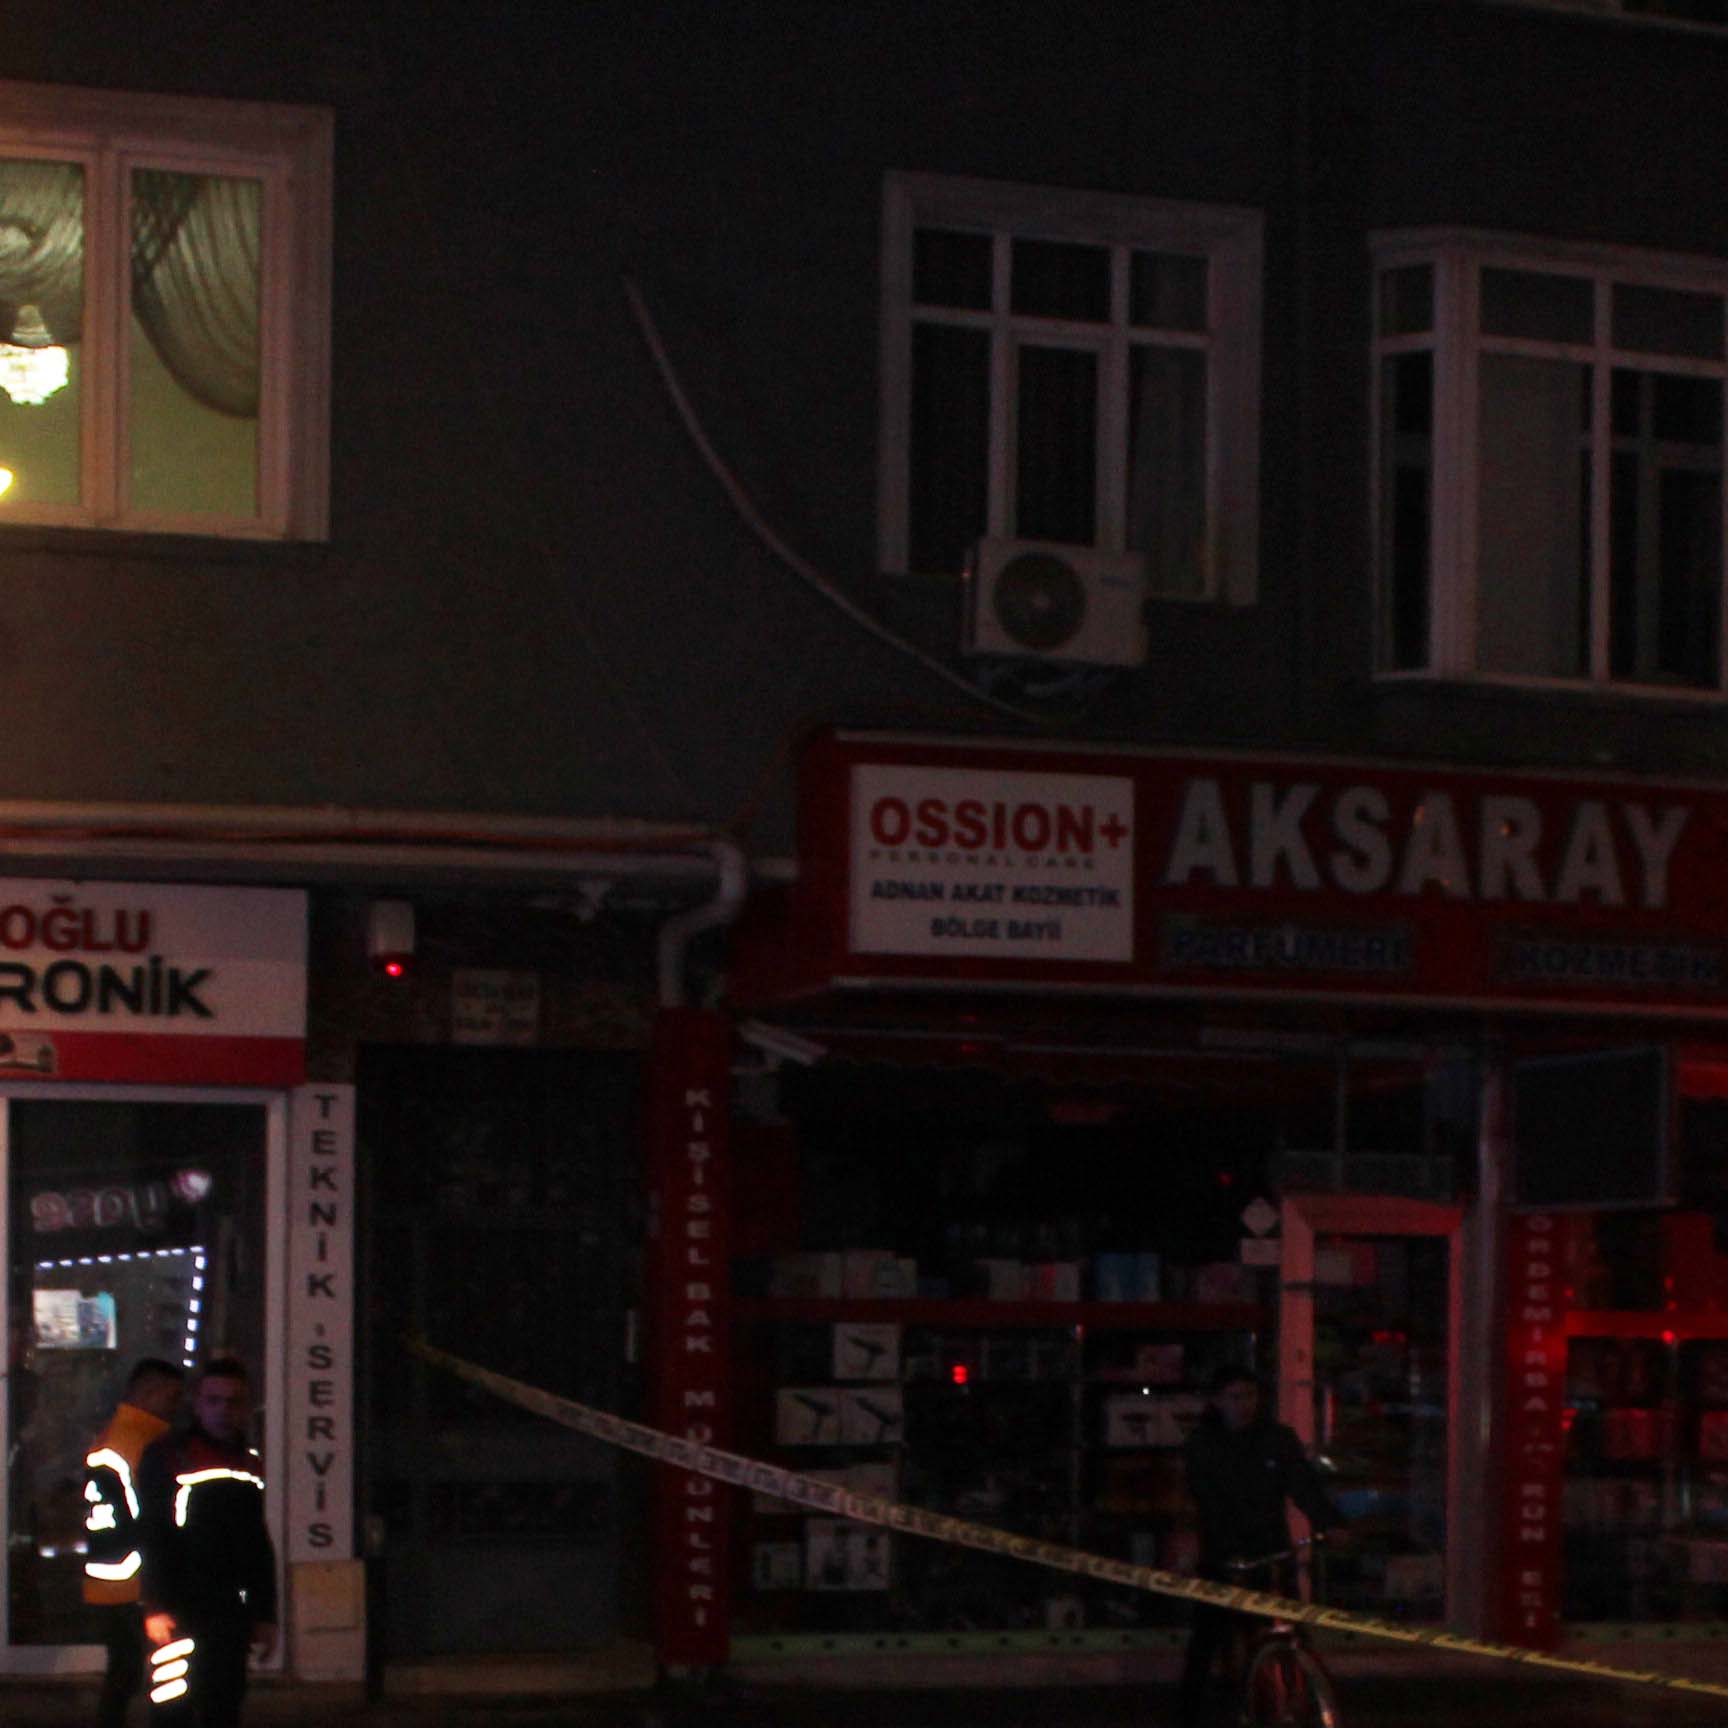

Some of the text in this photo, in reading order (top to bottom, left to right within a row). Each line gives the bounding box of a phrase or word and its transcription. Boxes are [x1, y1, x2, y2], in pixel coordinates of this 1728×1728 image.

[871, 879, 1122, 907] ADNAN AKAT KOZMETİK
[1161, 776, 1690, 912] AKSARAY
[930, 916, 999, 939] BÖLGE
[307, 1092, 338, 1550] TEKNİK SERVİS
[683, 1281, 716, 1409] BAKM
